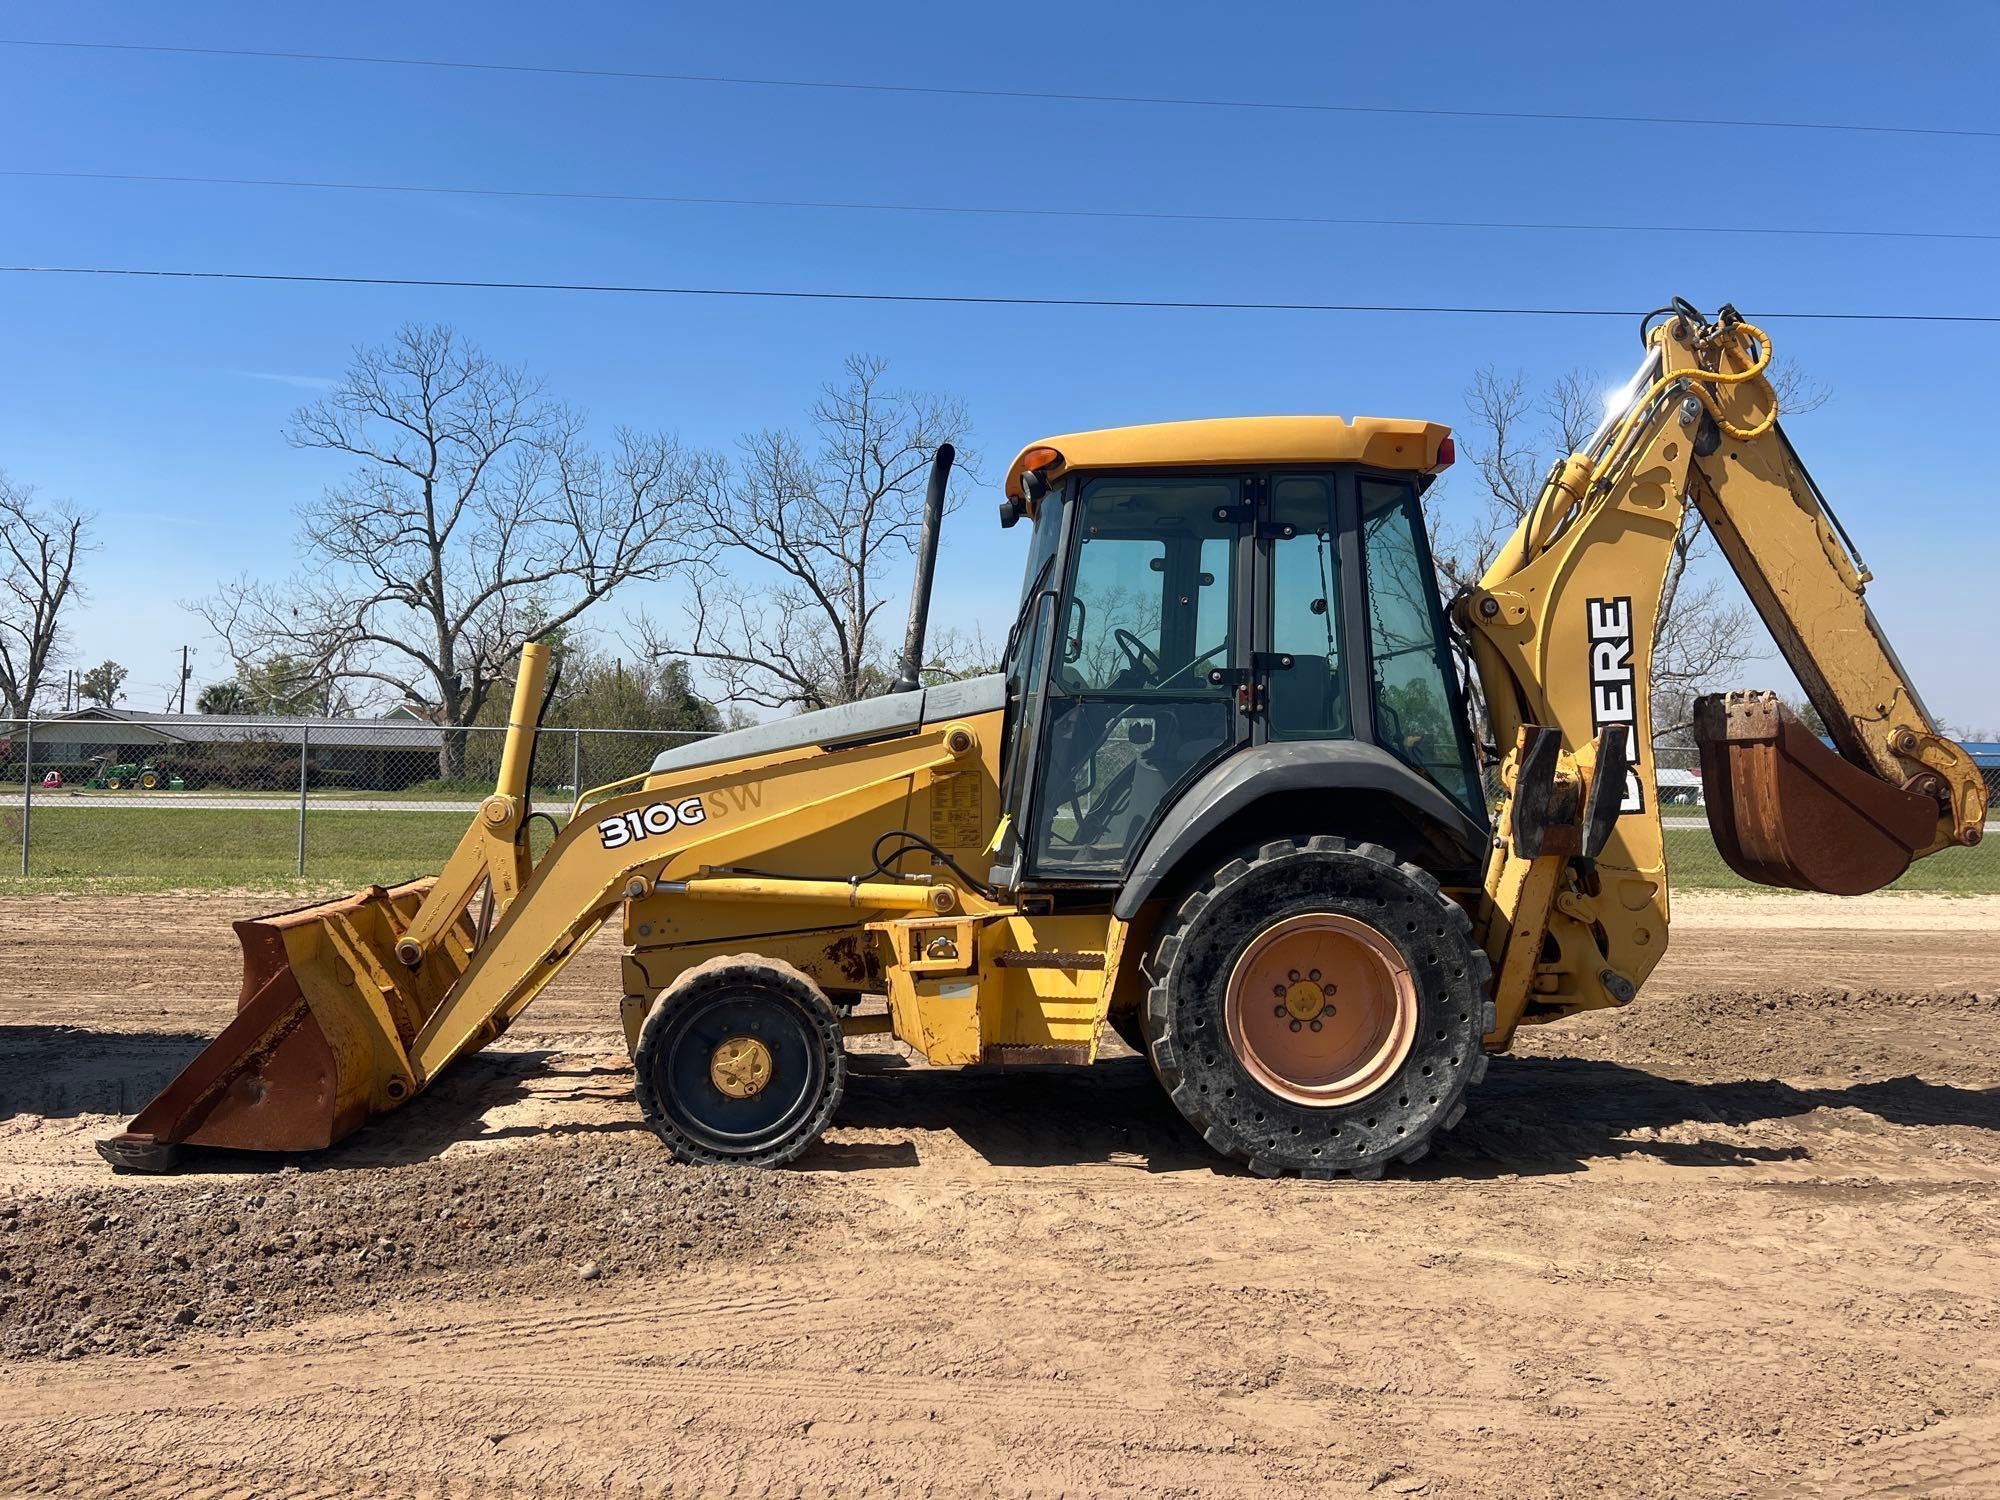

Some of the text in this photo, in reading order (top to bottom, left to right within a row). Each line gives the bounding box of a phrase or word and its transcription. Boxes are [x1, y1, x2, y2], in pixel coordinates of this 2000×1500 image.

[1586, 596, 1644, 813] ERE
[599, 782, 761, 848] 310G SW
